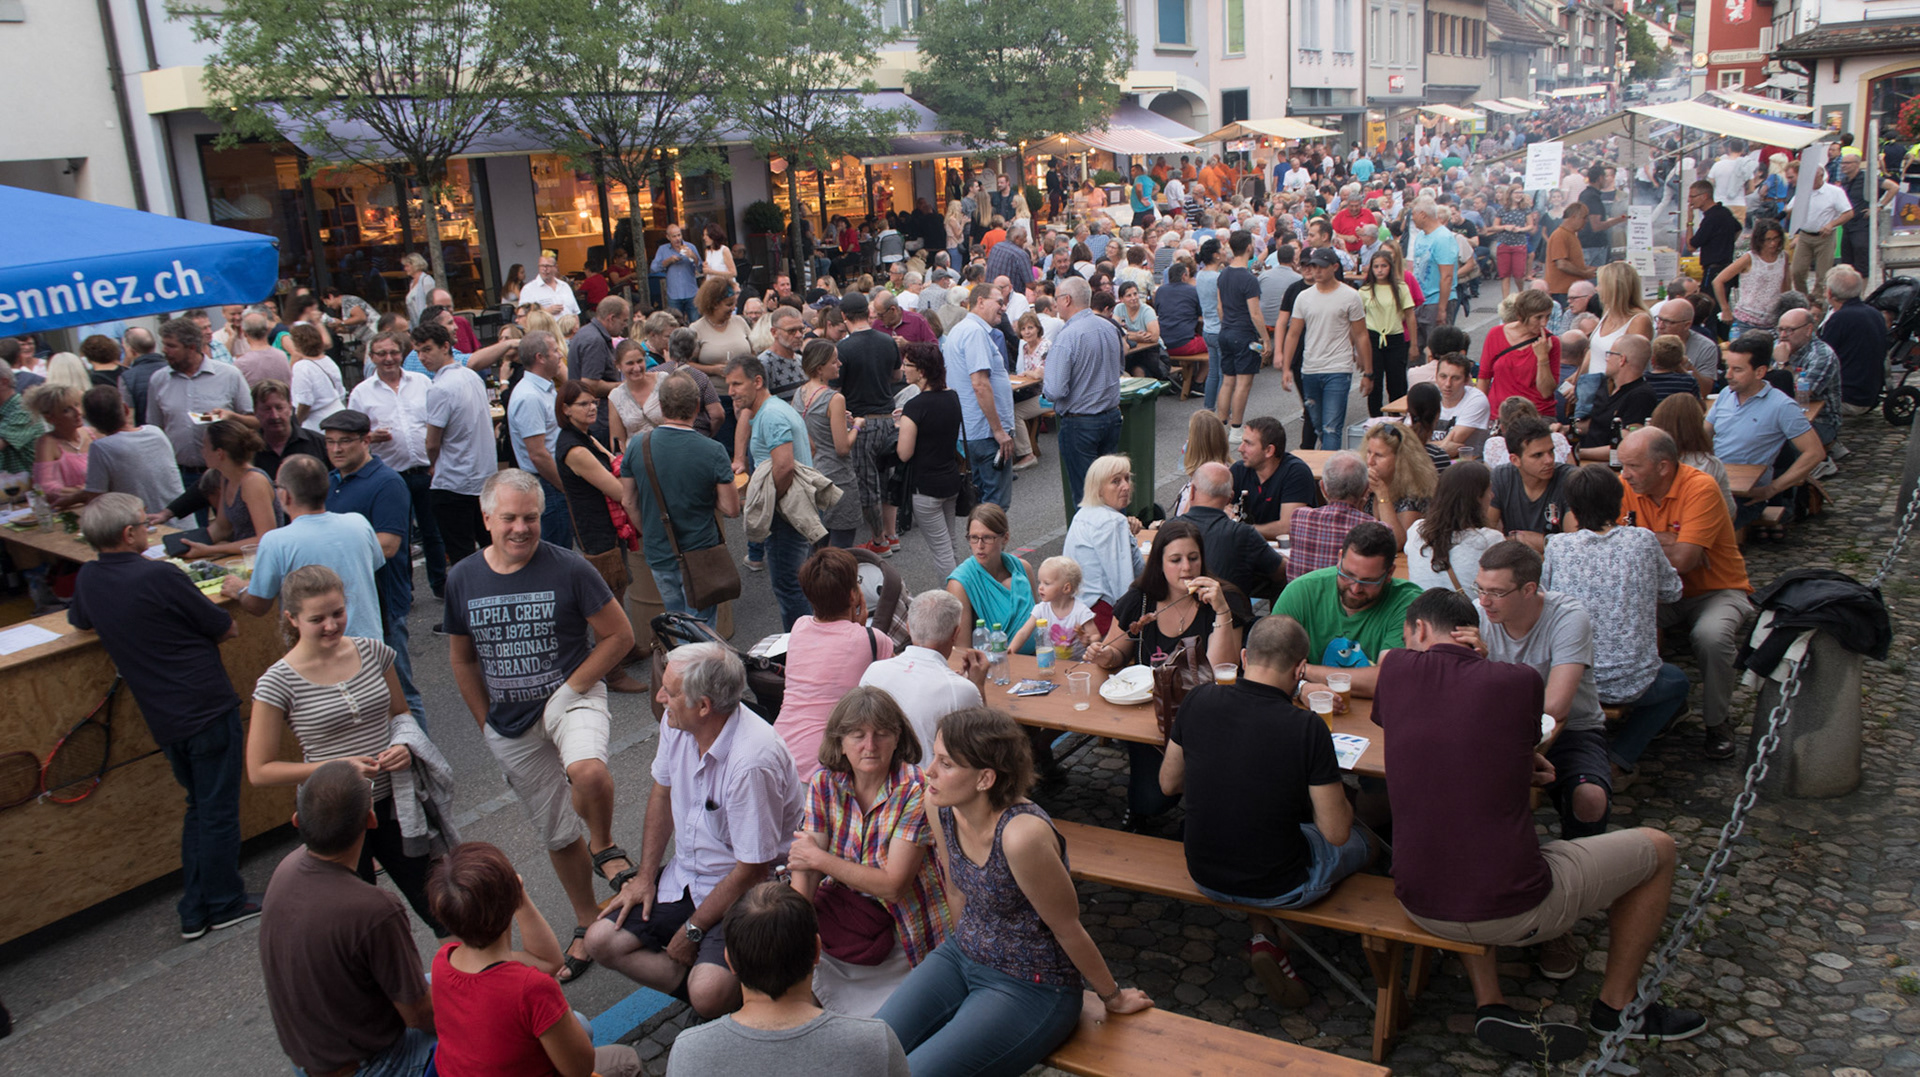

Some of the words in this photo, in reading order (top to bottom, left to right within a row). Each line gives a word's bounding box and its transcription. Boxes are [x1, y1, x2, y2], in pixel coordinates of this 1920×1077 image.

[0, 260, 204, 323] enniez.ch
[469, 598, 497, 608] EXPLICIT
[499, 594, 532, 604] SPORTING
[534, 592, 552, 601] CLUB
[470, 606, 511, 626] ALPHA
[515, 602, 556, 621] CREW
[505, 623, 531, 640] 1972
[533, 621, 556, 636] EST
[496, 637, 559, 657] ORIGINALS
